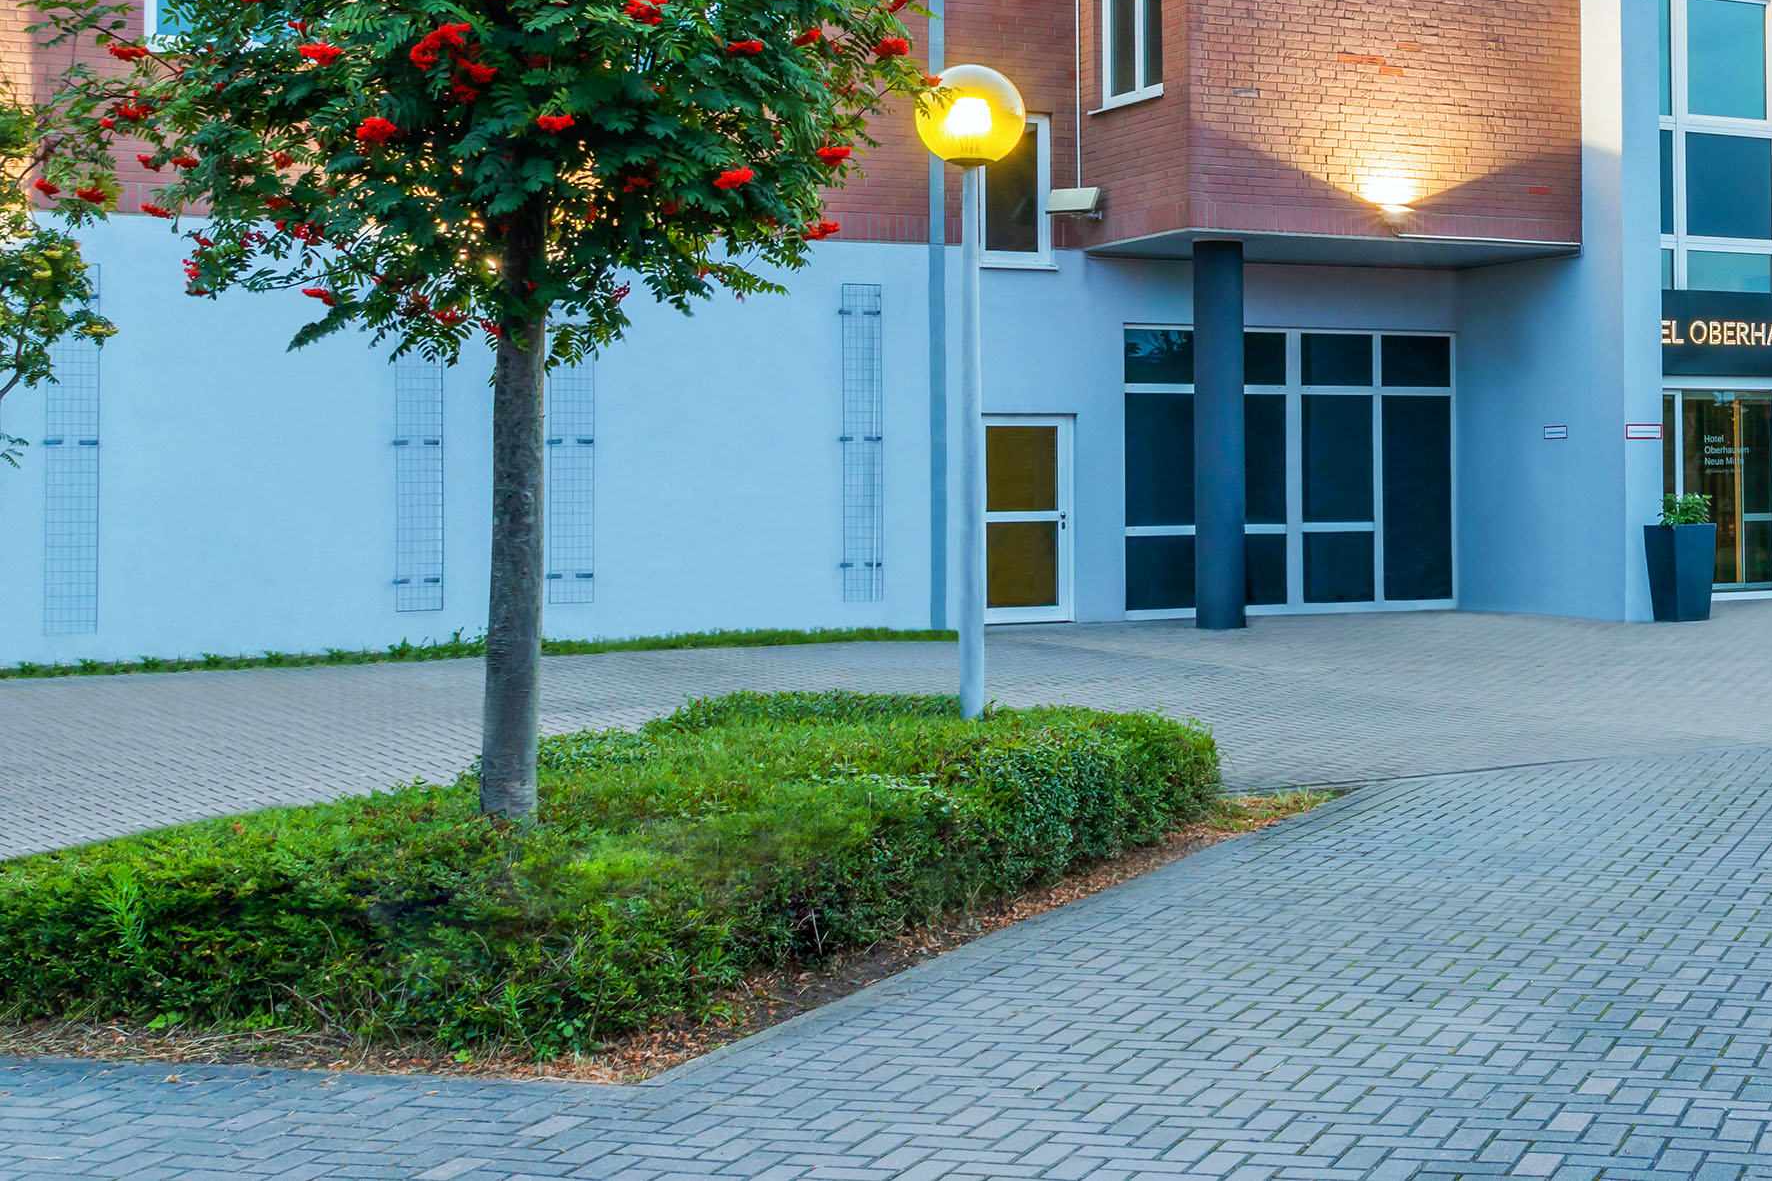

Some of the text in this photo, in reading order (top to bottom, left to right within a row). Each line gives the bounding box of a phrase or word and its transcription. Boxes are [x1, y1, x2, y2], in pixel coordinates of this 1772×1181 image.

[1704, 434, 1725, 443] Hotel
[1704, 445, 1750, 455] Oberhausen
[1704, 457, 1725, 466] Neue
